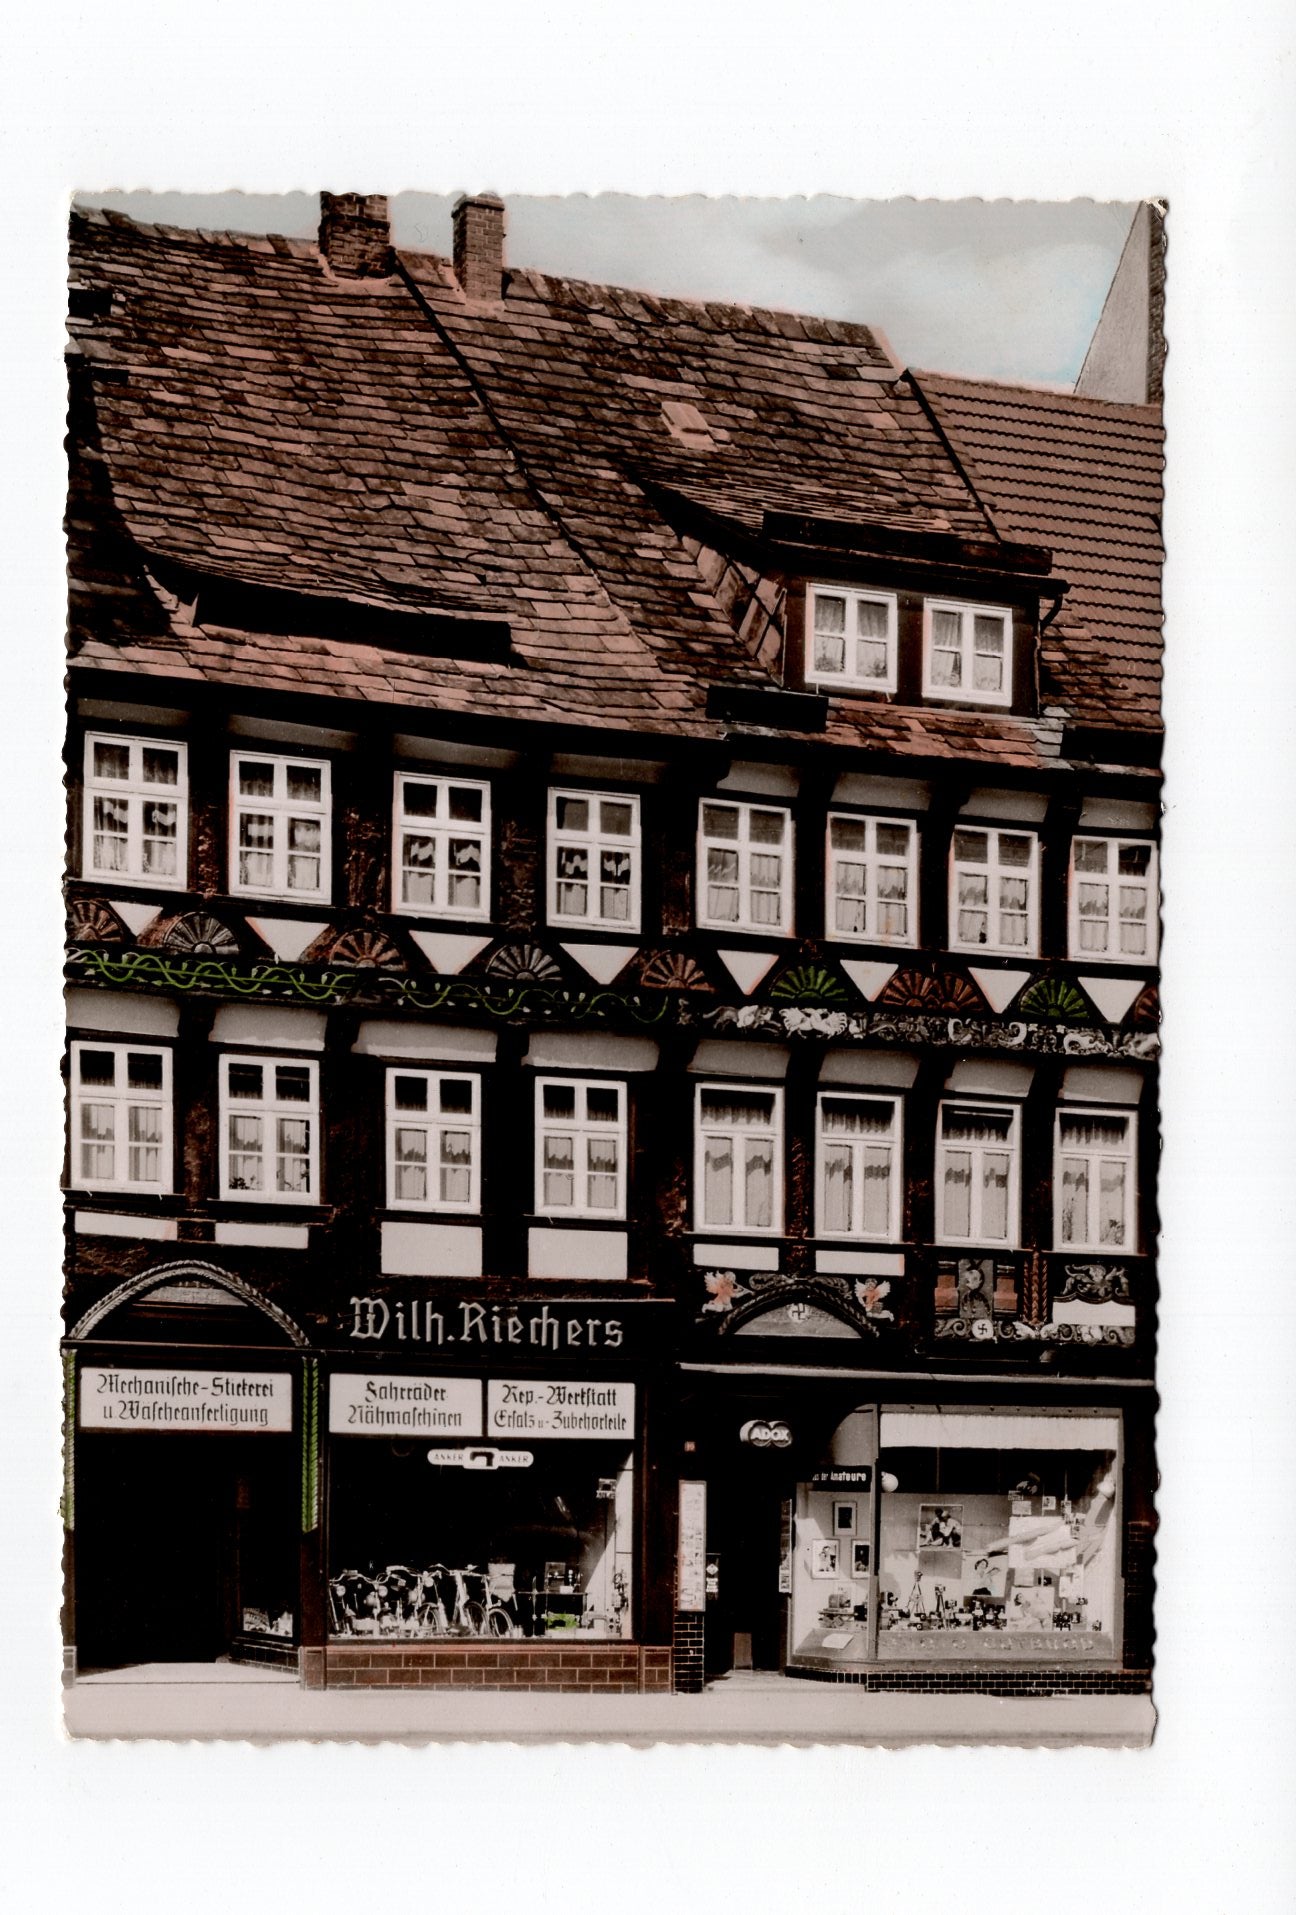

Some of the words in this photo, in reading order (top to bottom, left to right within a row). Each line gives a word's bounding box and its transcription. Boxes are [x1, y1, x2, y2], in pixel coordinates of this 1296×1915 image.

[458, 1301, 624, 1351] Riechers
[364, 1380, 447, 1403] Fahrräder
[749, 1427, 790, 1441] ADOX
[434, 1453, 464, 1461] ANKER
[499, 1455, 529, 1463] ANKER
